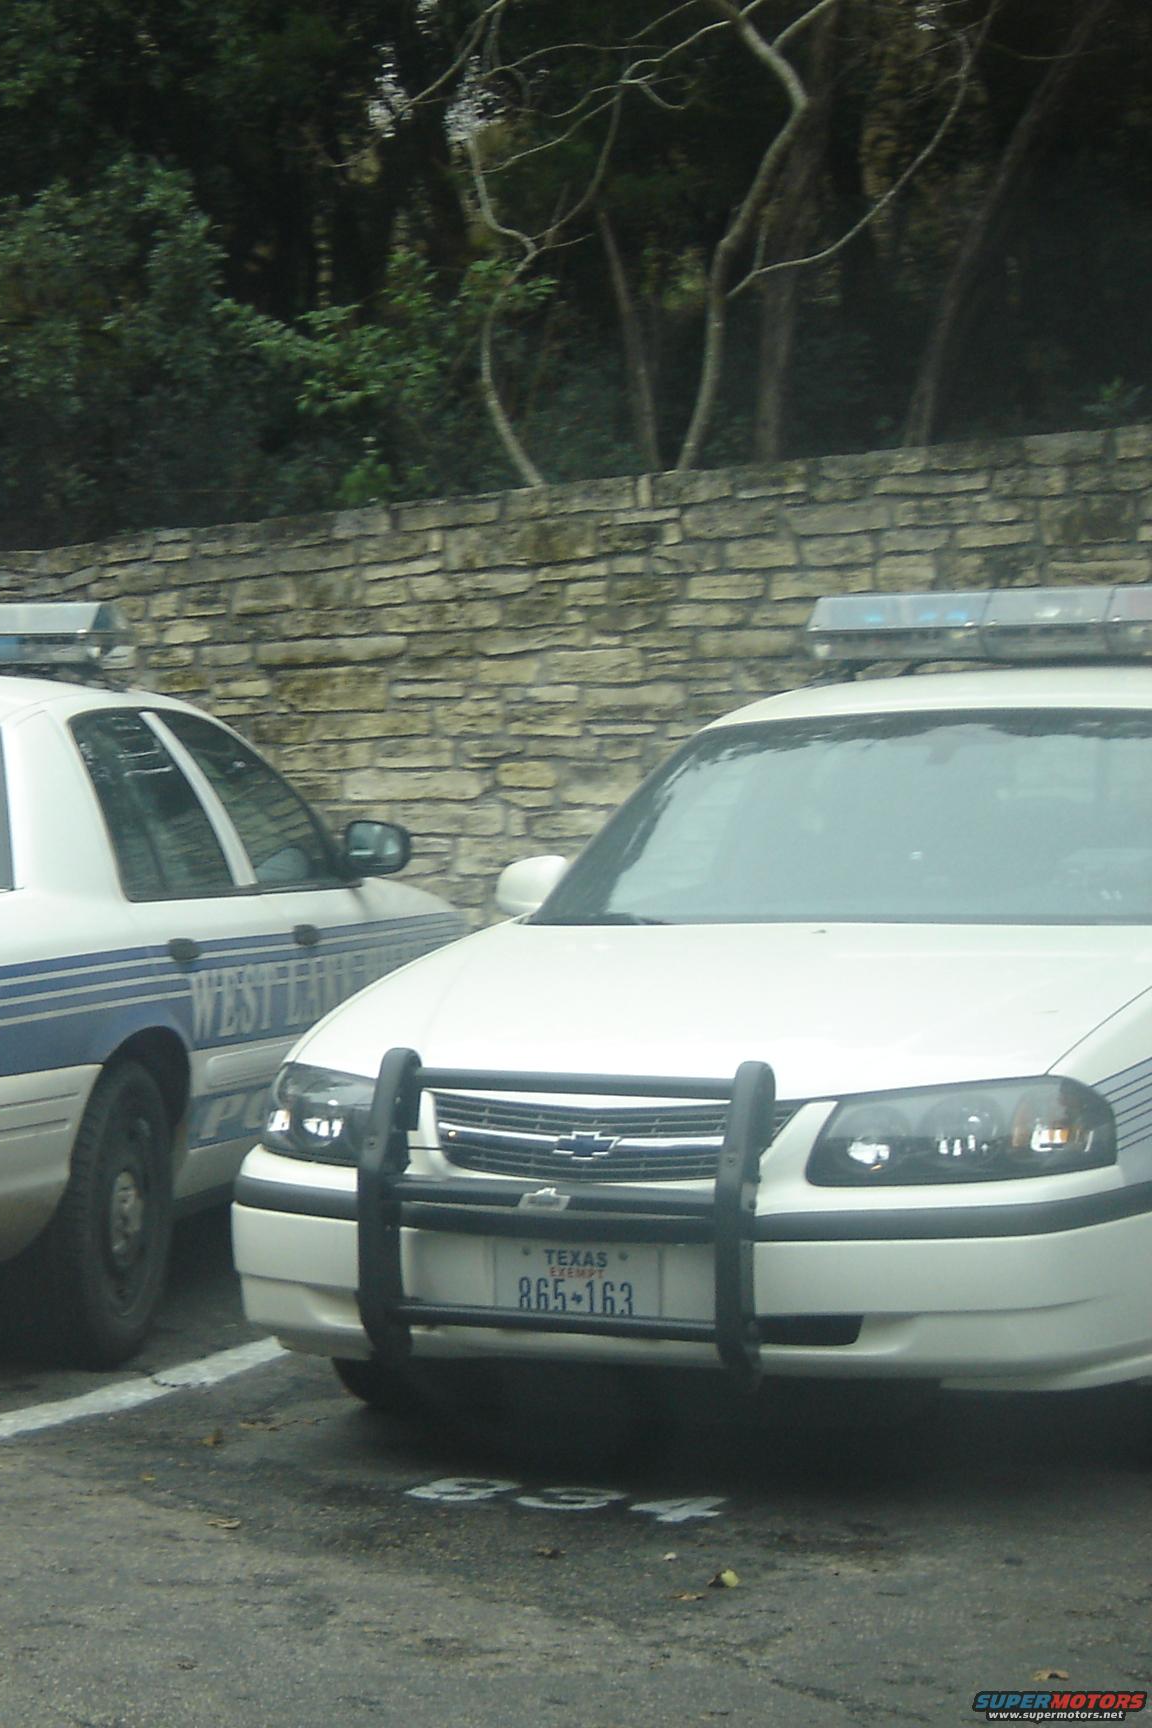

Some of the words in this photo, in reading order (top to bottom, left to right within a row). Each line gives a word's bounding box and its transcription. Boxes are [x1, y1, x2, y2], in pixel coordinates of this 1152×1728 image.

[190, 962, 276, 1040] WEST
[544, 1249, 608, 1268] TEXAS
[550, 1267, 605, 1279] EXEMPT
[404, 1477, 727, 1522] 834
